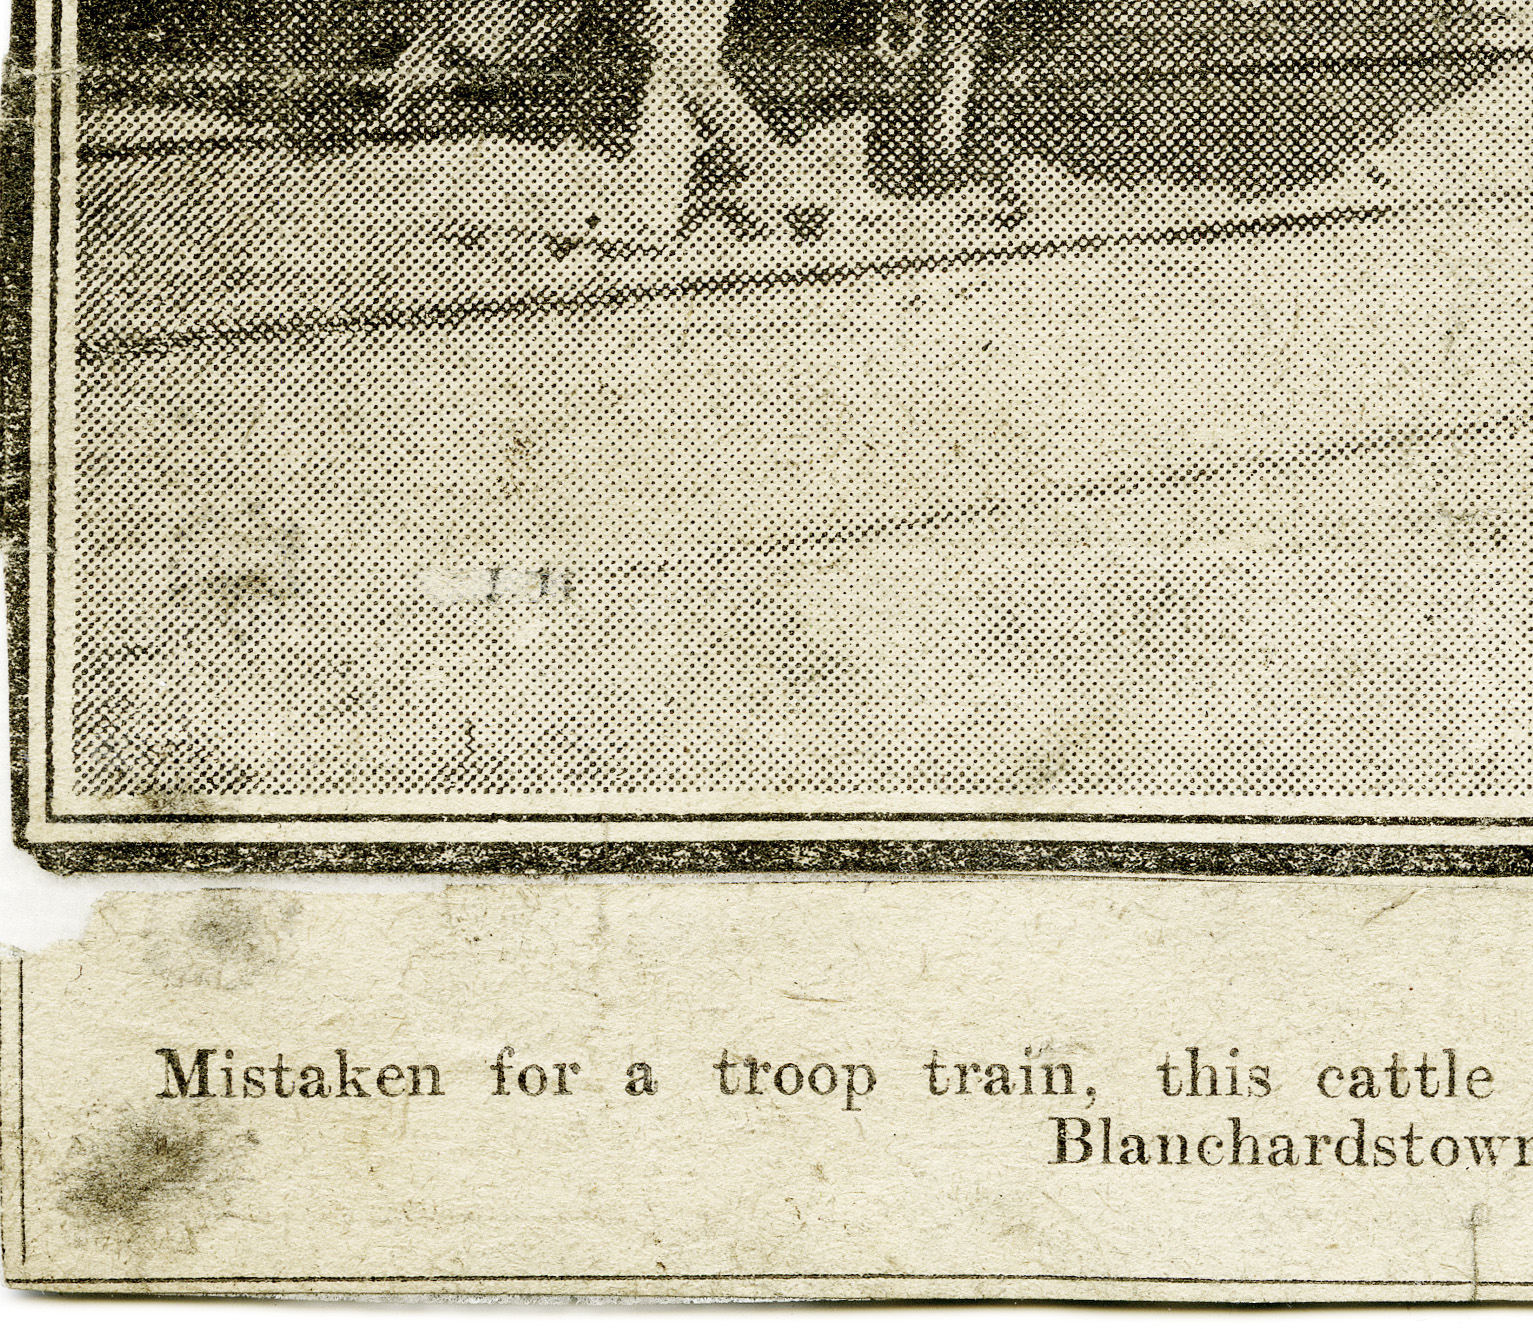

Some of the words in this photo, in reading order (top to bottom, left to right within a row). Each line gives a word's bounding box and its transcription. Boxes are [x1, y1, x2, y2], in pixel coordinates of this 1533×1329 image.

[155, 1047, 443, 1098] Mistaken
[488, 1046, 580, 1097] for
[624, 1061, 658, 1096] a
[713, 1048, 876, 1112] troop
[925, 1046, 1095, 1109] train,
[1156, 1046, 1272, 1098] this
[1317, 1049, 1494, 1100] cattle
